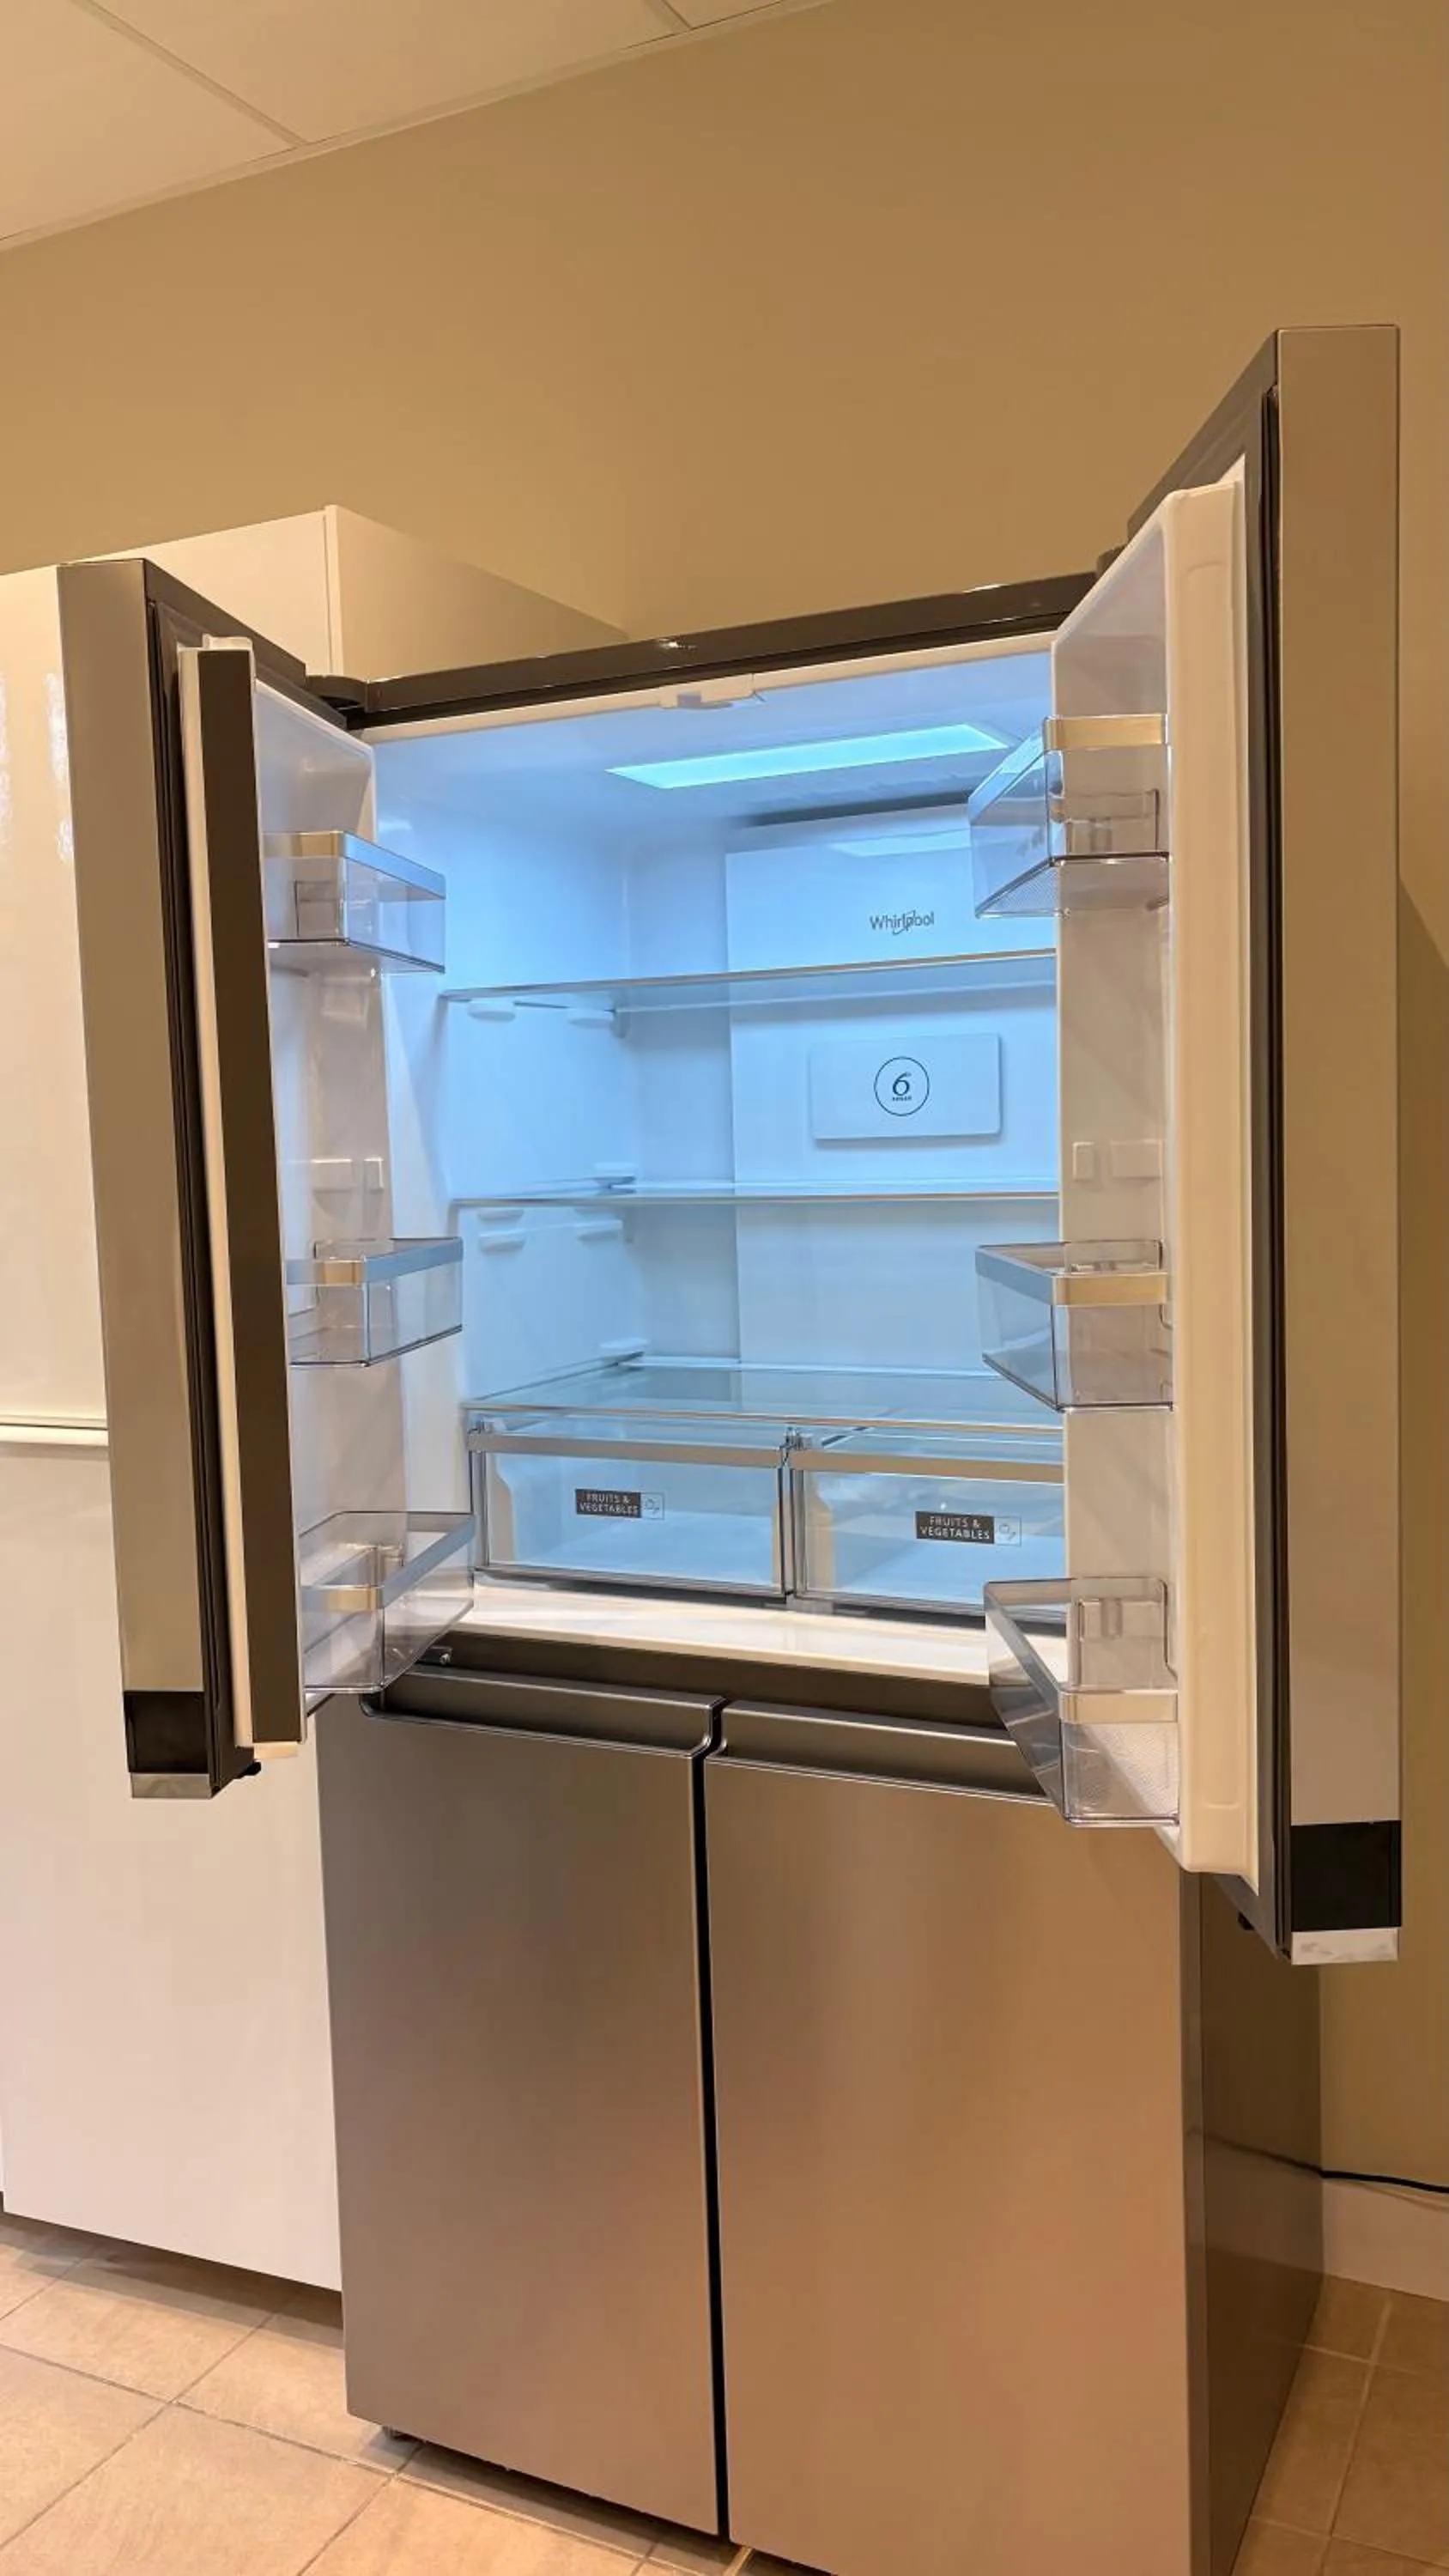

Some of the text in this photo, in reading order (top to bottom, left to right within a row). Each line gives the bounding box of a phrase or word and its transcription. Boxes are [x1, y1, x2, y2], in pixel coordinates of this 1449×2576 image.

[869, 909, 935, 936] Whirlpool
[892, 1072, 912, 1096] 6
[585, 1492, 631, 1504] FRUITS &
[578, 1502, 639, 1515] VEGETABLES
[930, 1516, 981, 1528] FRUITS &
[919, 1526, 990, 1540] VEGETABLES
